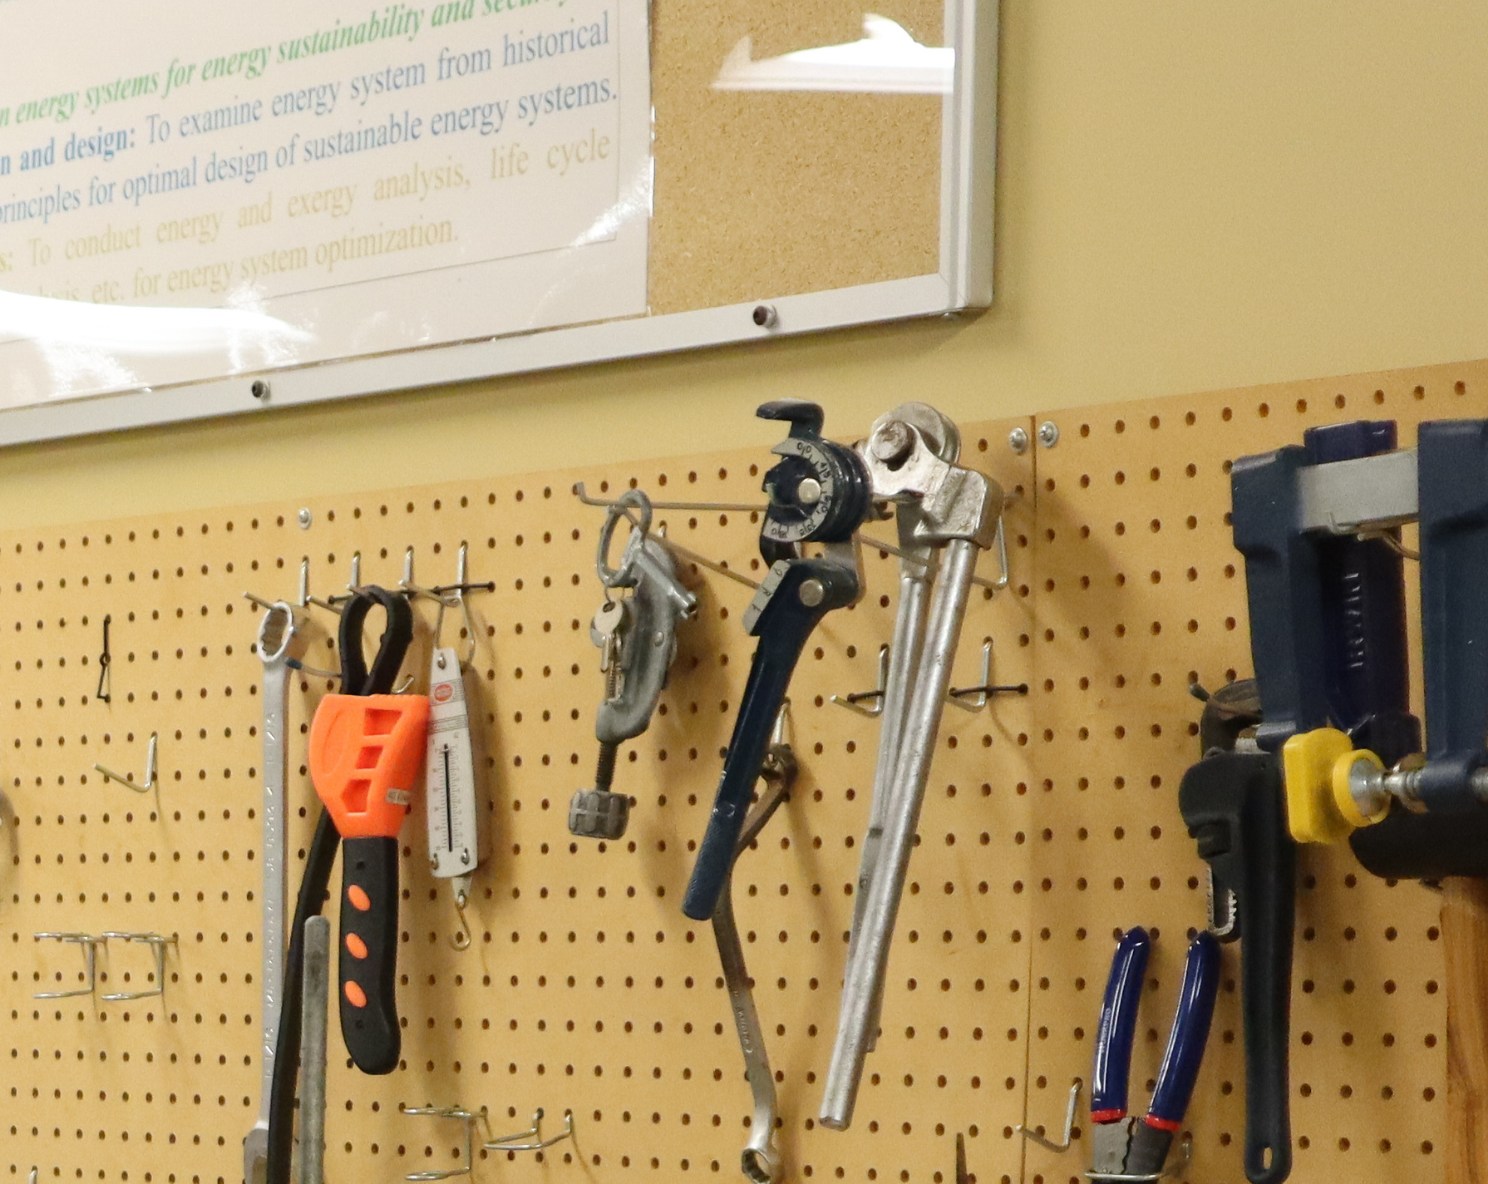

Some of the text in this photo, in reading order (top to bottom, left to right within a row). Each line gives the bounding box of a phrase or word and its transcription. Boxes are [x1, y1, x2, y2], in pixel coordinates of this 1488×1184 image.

[15, 91, 80, 125] energy
[83, 72, 158, 115] systems
[162, 57, 196, 100] for
[201, 45, 271, 82] energy
[276, 4, 425, 64] sustainability
[430, 0, 474, 28] and
[19, 137, 55, 172] and
[63, 126, 136, 163] design:
[145, 113, 171, 145] To
[178, 99, 262, 138] examine
[271, 82, 340, 118] energy
[350, 62, 425, 107] system
[437, 46, 492, 81] from
[502, 10, 610, 68] historical
[30, 238, 51, 266] To
[64, 224, 141, 260] conduct
[156, 213, 224, 245] energy
[237, 192, 273, 228] and
[287, 186, 356, 218] exergy
[373, 163, 470, 202] analysis,
[490, 142, 529, 180] life
[546, 128, 610, 177] cycle
[88, 175, 116, 207] for
[122, 156, 197, 207] optimal
[204, 146, 267, 184] design
[275, 133, 298, 169] of
[302, 111, 422, 163] sustainable
[430, 100, 508, 137] energy
[517, 78, 617, 127] systems.
[133, 268, 161, 298] for
[167, 263, 233, 293] energy
[240, 247, 308, 279] system
[314, 220, 458, 273] optimization.
